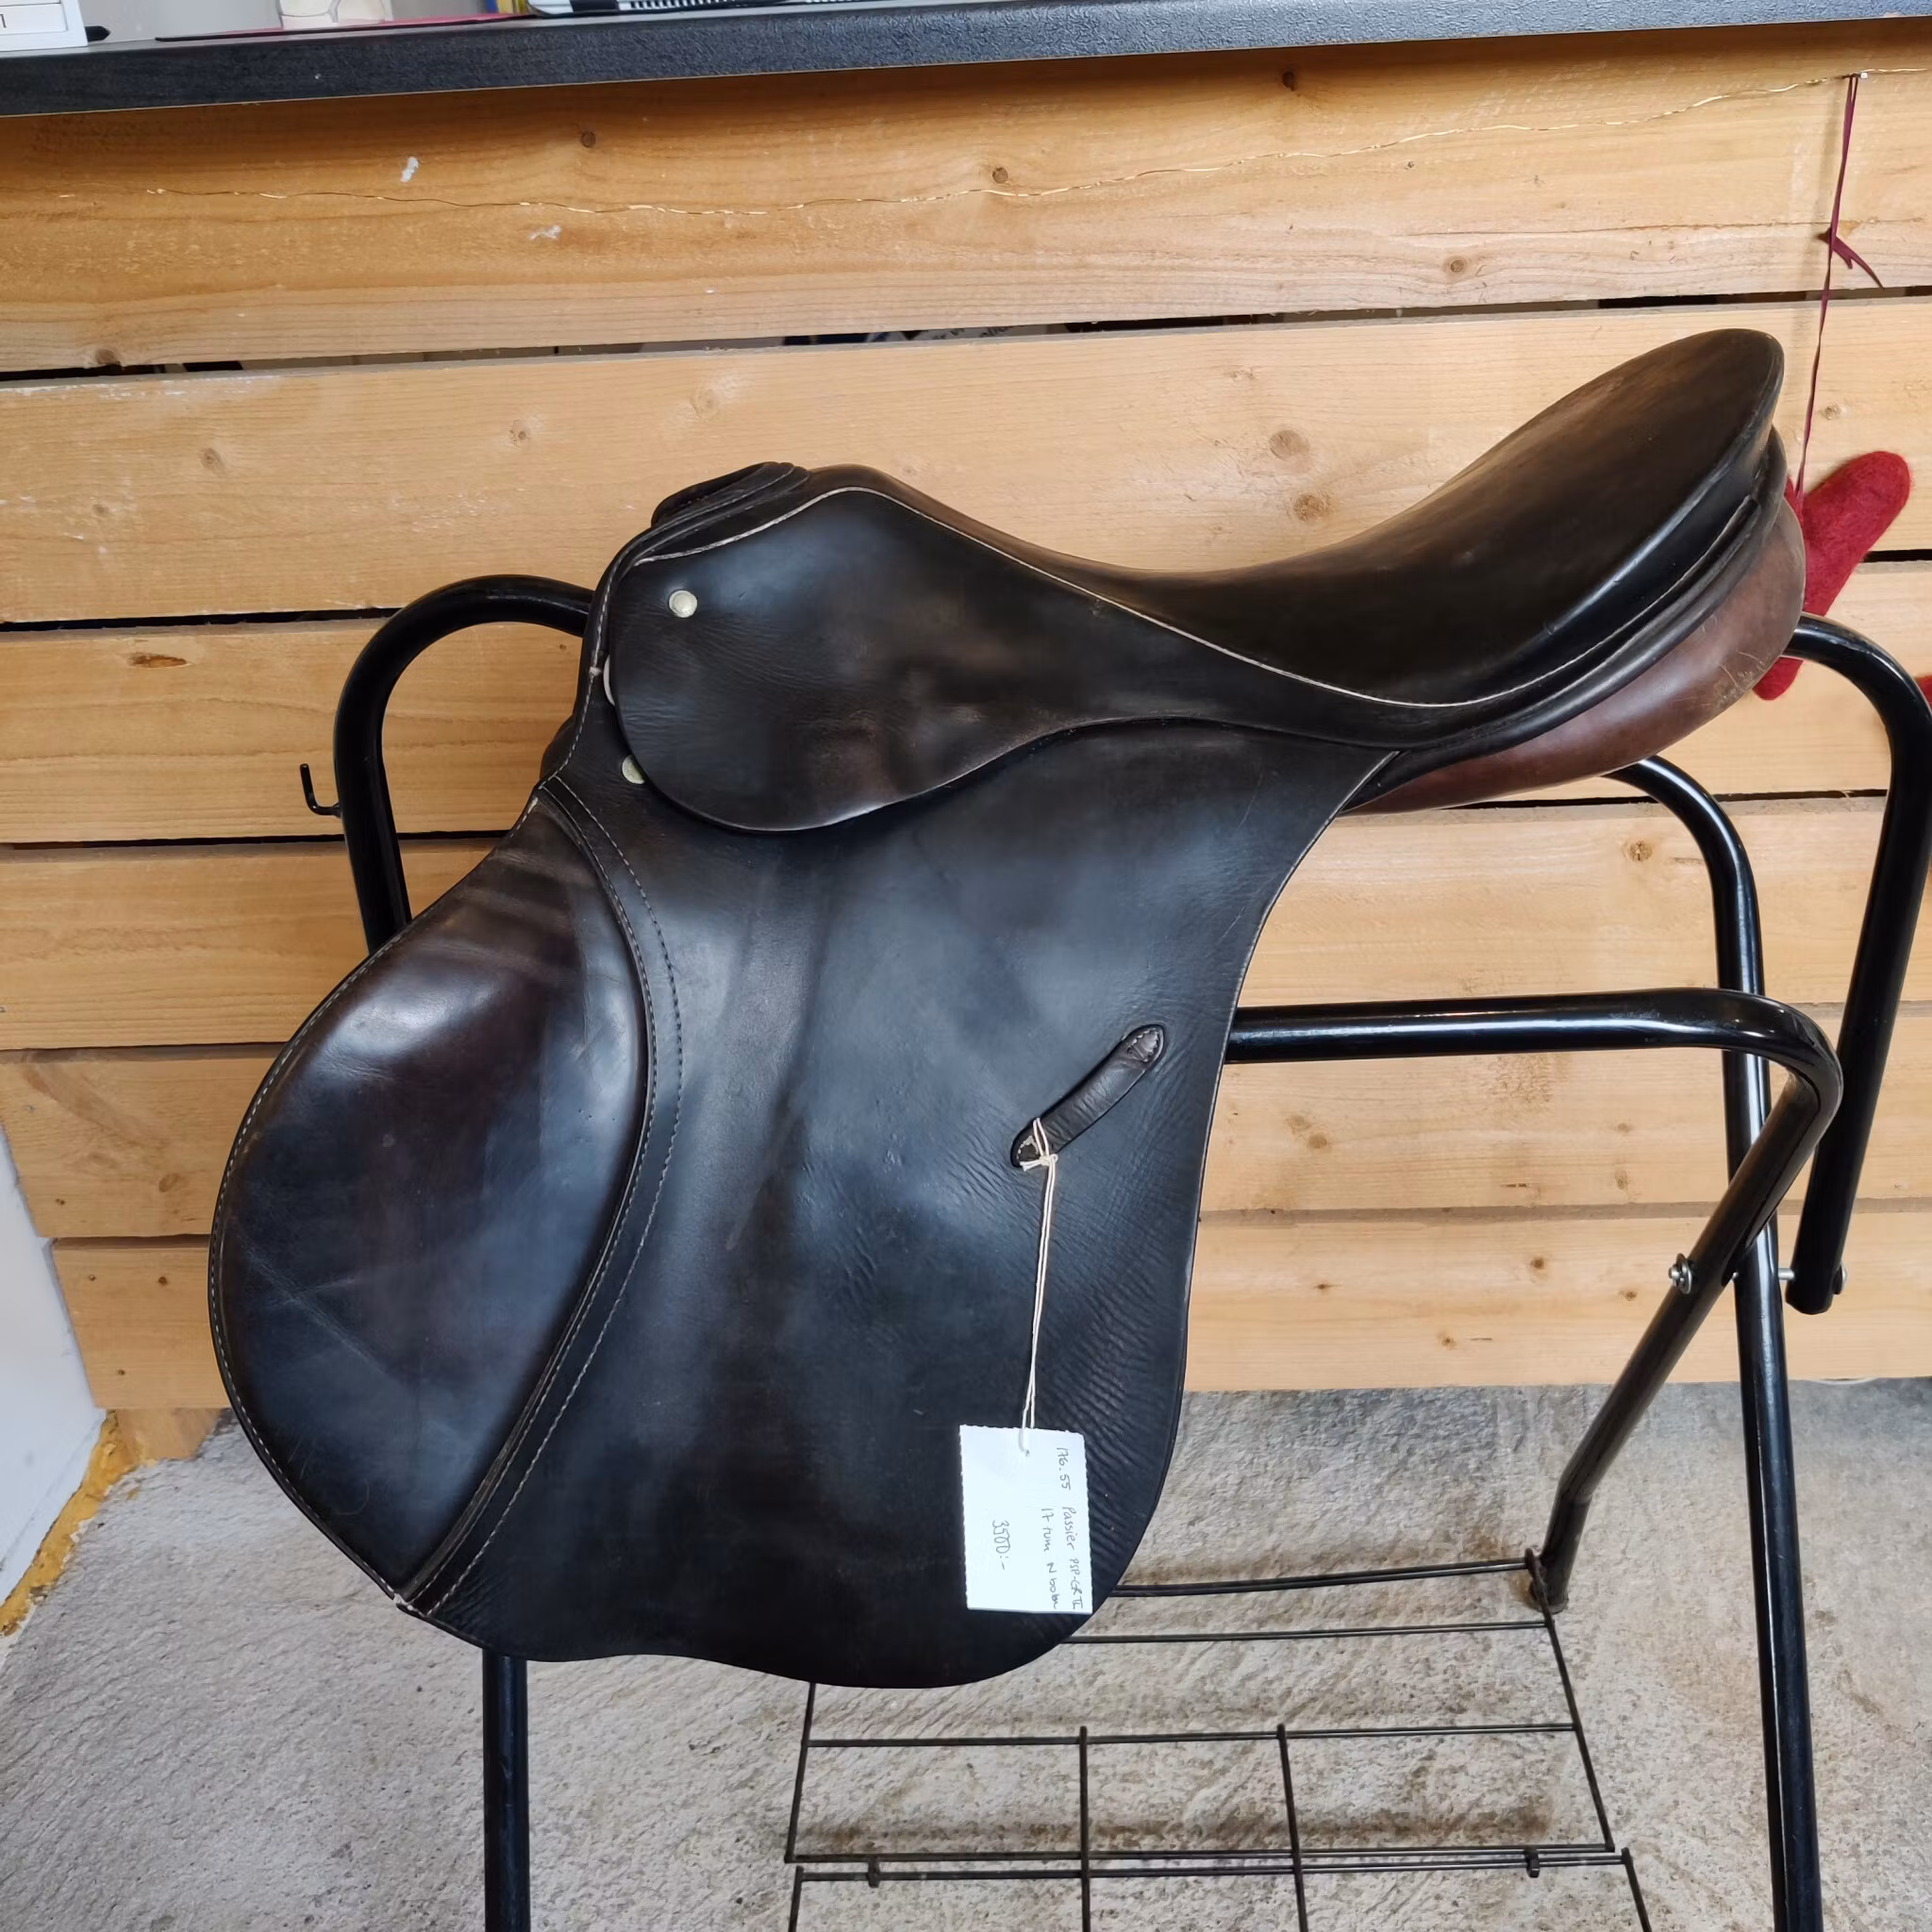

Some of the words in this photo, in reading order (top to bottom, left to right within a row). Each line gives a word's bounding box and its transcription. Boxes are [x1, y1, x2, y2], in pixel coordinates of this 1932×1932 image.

[1056, 1446, 1072, 1491] 176.55
[1041, 1507, 1055, 1523] 17
[1061, 1506, 1077, 1551] Passier
